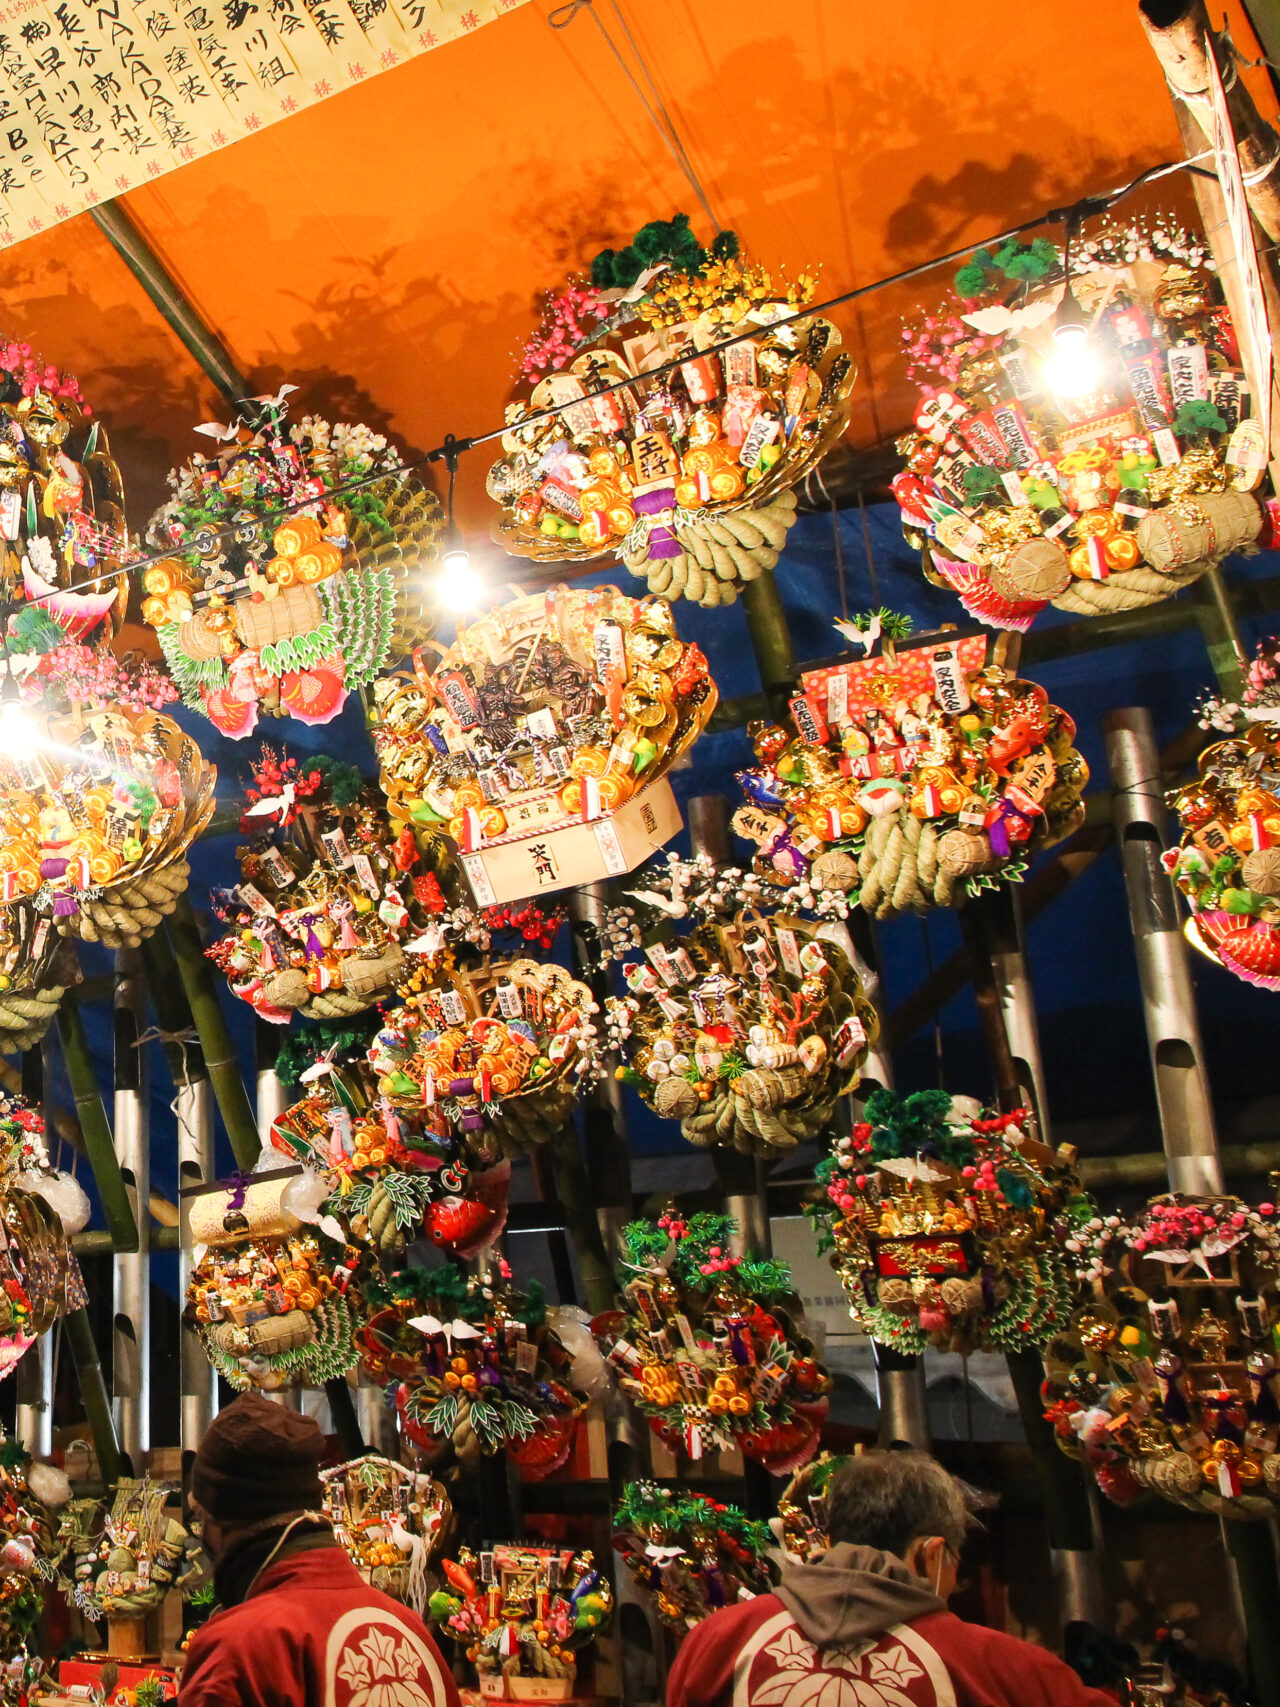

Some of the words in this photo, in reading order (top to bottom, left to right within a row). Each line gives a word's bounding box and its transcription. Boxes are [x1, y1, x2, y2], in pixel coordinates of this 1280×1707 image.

[82, 0, 190, 149] NAKADA美装
[174, 0, 249, 101] 電気工事
[526, 843, 557, 883] 笑門
